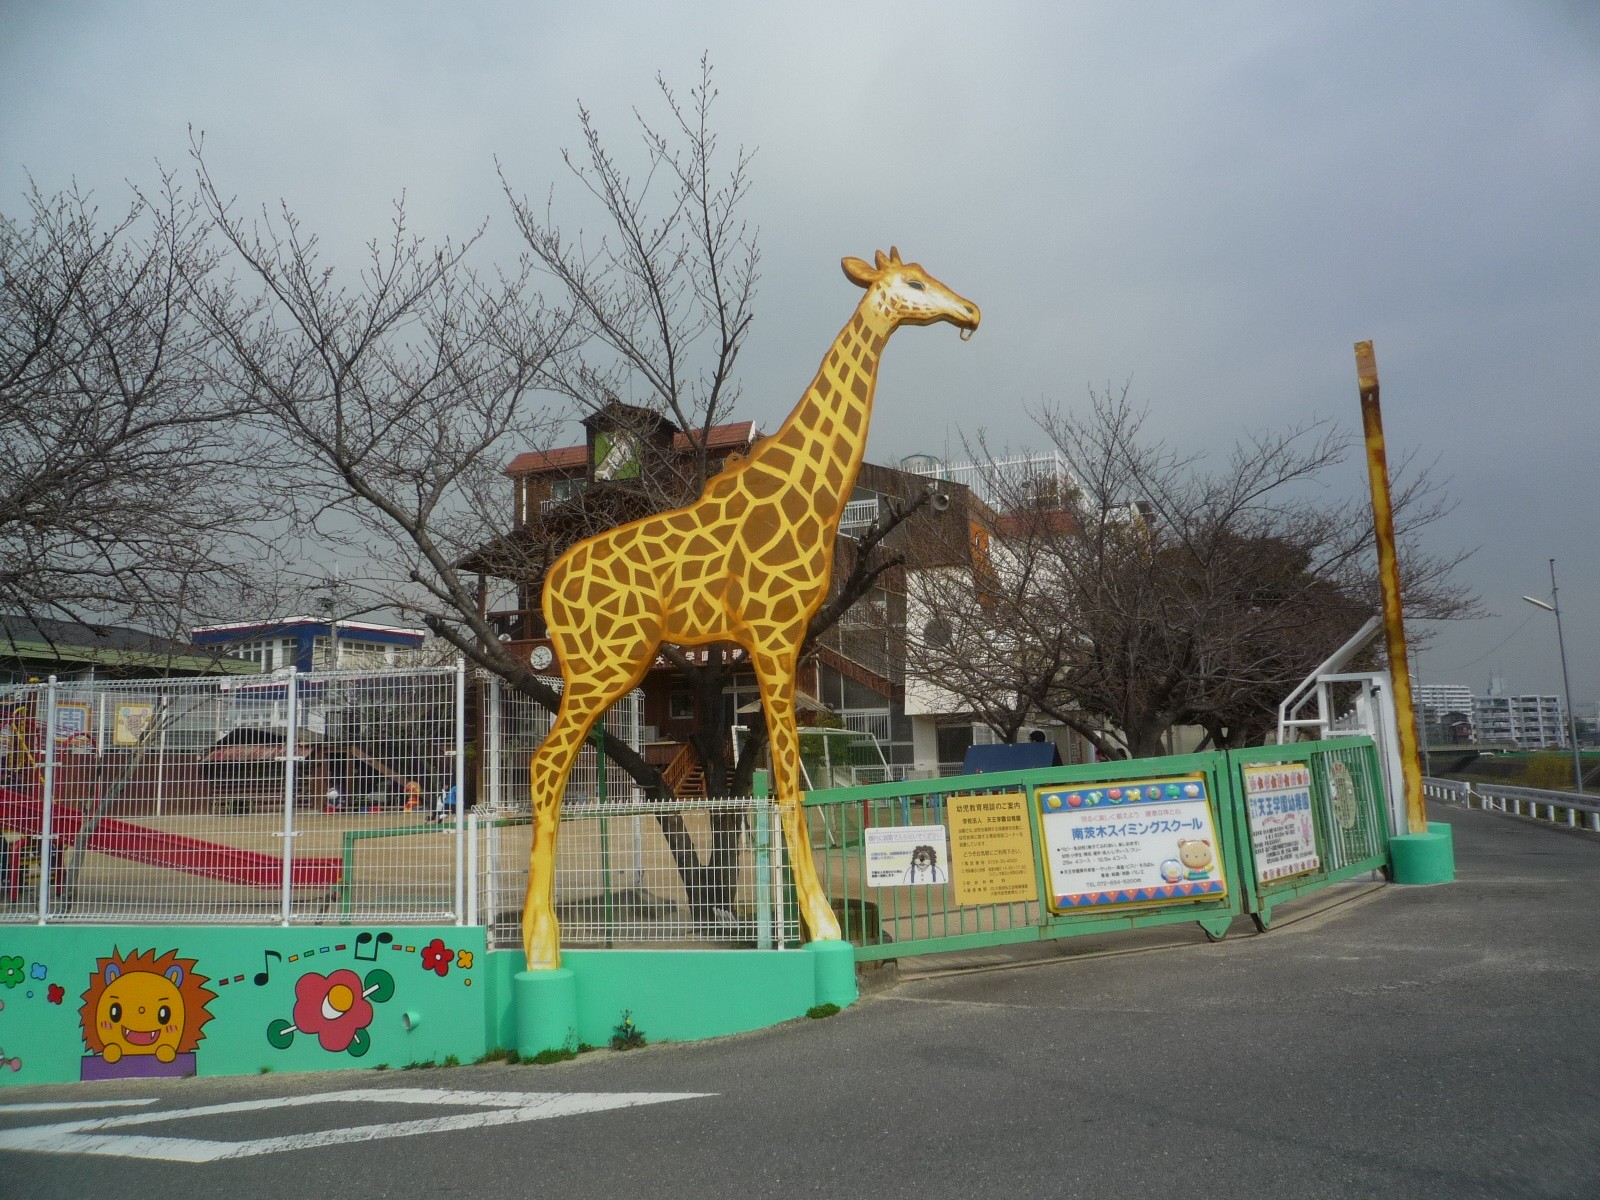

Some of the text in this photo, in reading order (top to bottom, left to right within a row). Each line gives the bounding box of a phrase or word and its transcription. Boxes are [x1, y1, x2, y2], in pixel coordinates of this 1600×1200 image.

[956, 802, 1020, 813] 幼児教育相談のご案内
[1257, 792, 1309, 816] 天王学園幼稚園
[1072, 818, 1203, 840] 南茨木スイミングスクール
